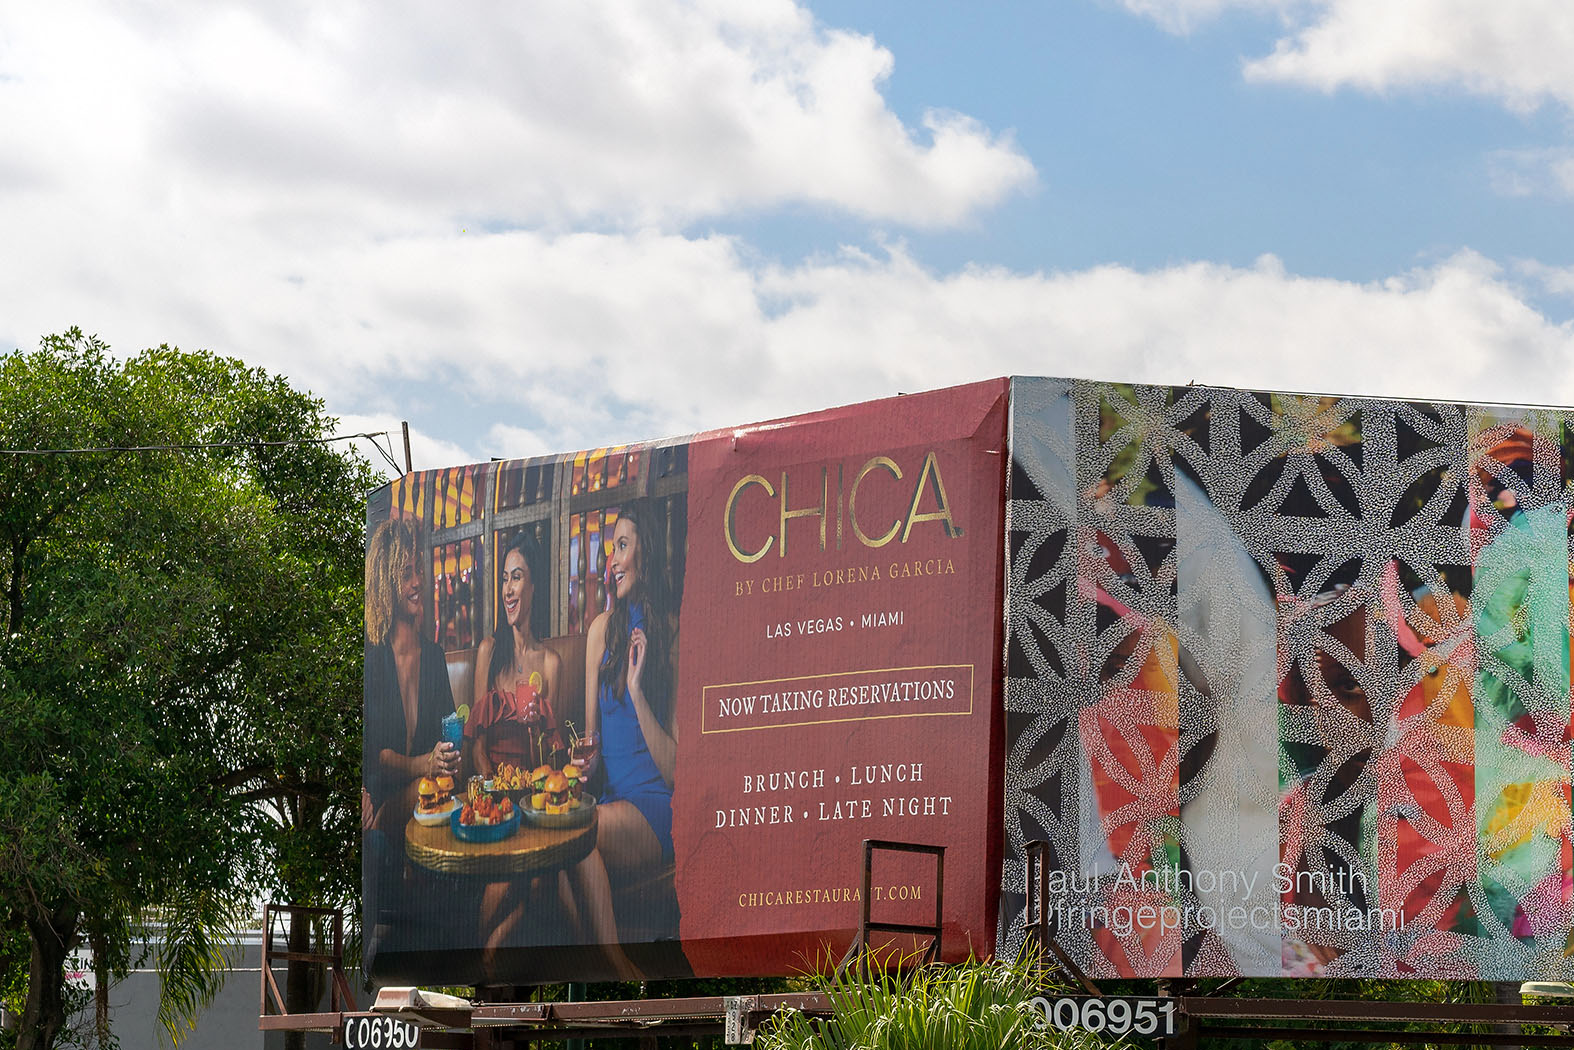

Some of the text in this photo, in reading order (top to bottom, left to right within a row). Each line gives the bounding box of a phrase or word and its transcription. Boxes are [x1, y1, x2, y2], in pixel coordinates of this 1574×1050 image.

[723, 451, 962, 563] CHICA
[735, 559, 956, 596] BY CHEF LORENA GARCIA
[766, 611, 904, 639] LAS VEGAS MIAMI
[718, 680, 955, 718] NOW TAKING RESERVATIONS
[743, 763, 924, 793] BRUNCH LUNCH
[715, 796, 952, 828] DINNER LATE NIGHT
[738, 885, 921, 907] CHICARESTAURAT.COM
[1113, 862, 1259, 899] Anthony
[1272, 862, 1368, 895] Smith
[1029, 996, 1174, 1034] 006951
